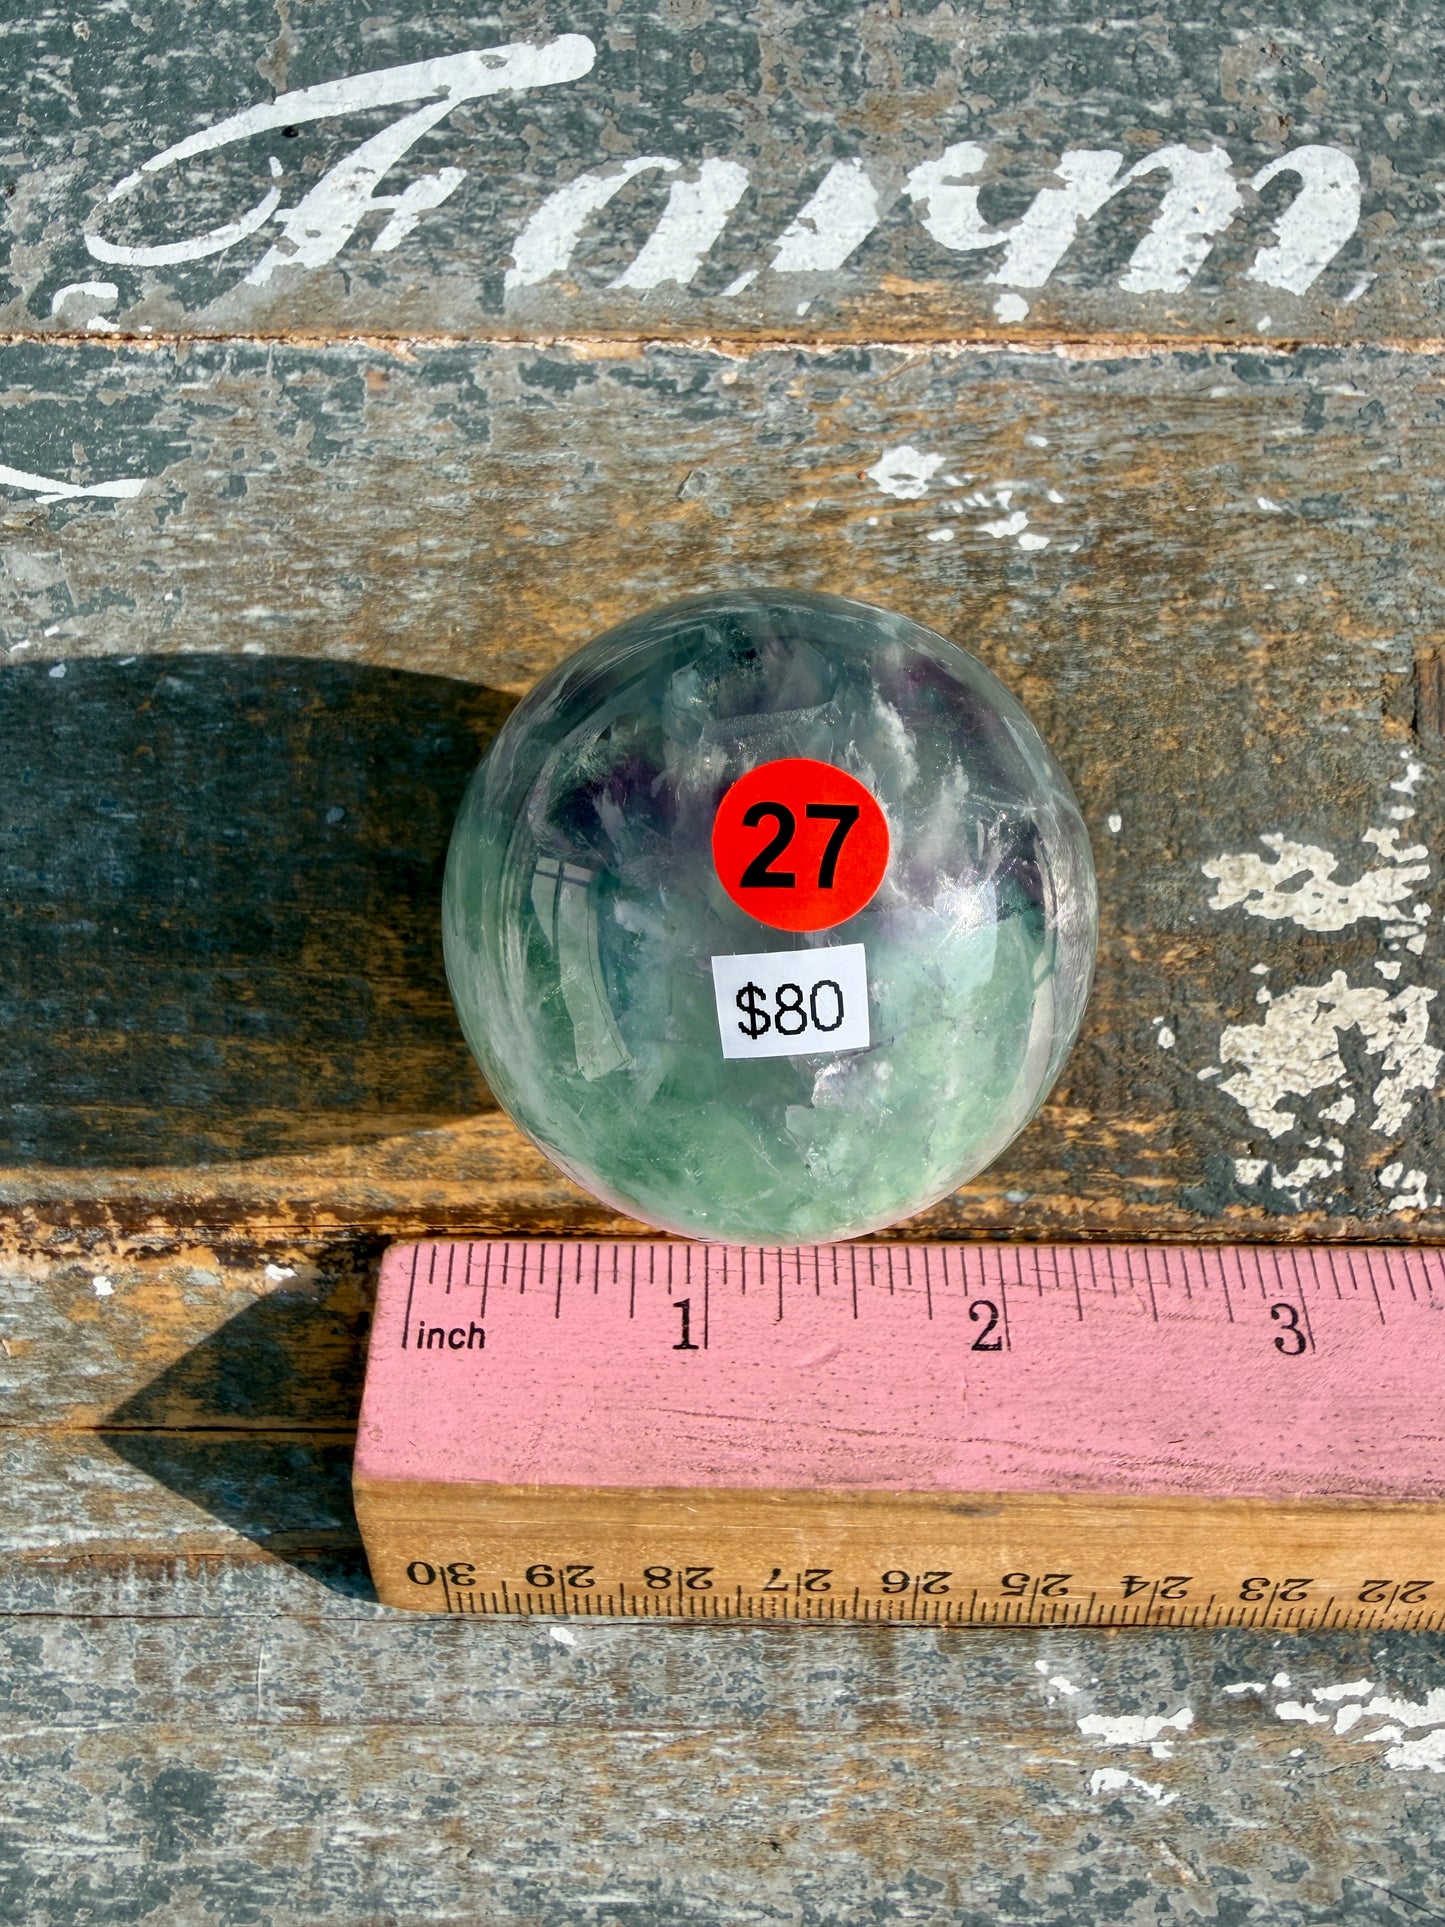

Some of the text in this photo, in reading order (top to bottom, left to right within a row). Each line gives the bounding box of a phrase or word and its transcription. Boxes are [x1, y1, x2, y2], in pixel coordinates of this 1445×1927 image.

[52, 33, 1374, 325] Farm
[739, 801, 861, 889] 27
[736, 979, 845, 1040] $80
[416, 1298, 1307, 1356] inch 1 2 3
[406, 1560, 1436, 1603] 22 23 24 25 26 27 28 29 30
